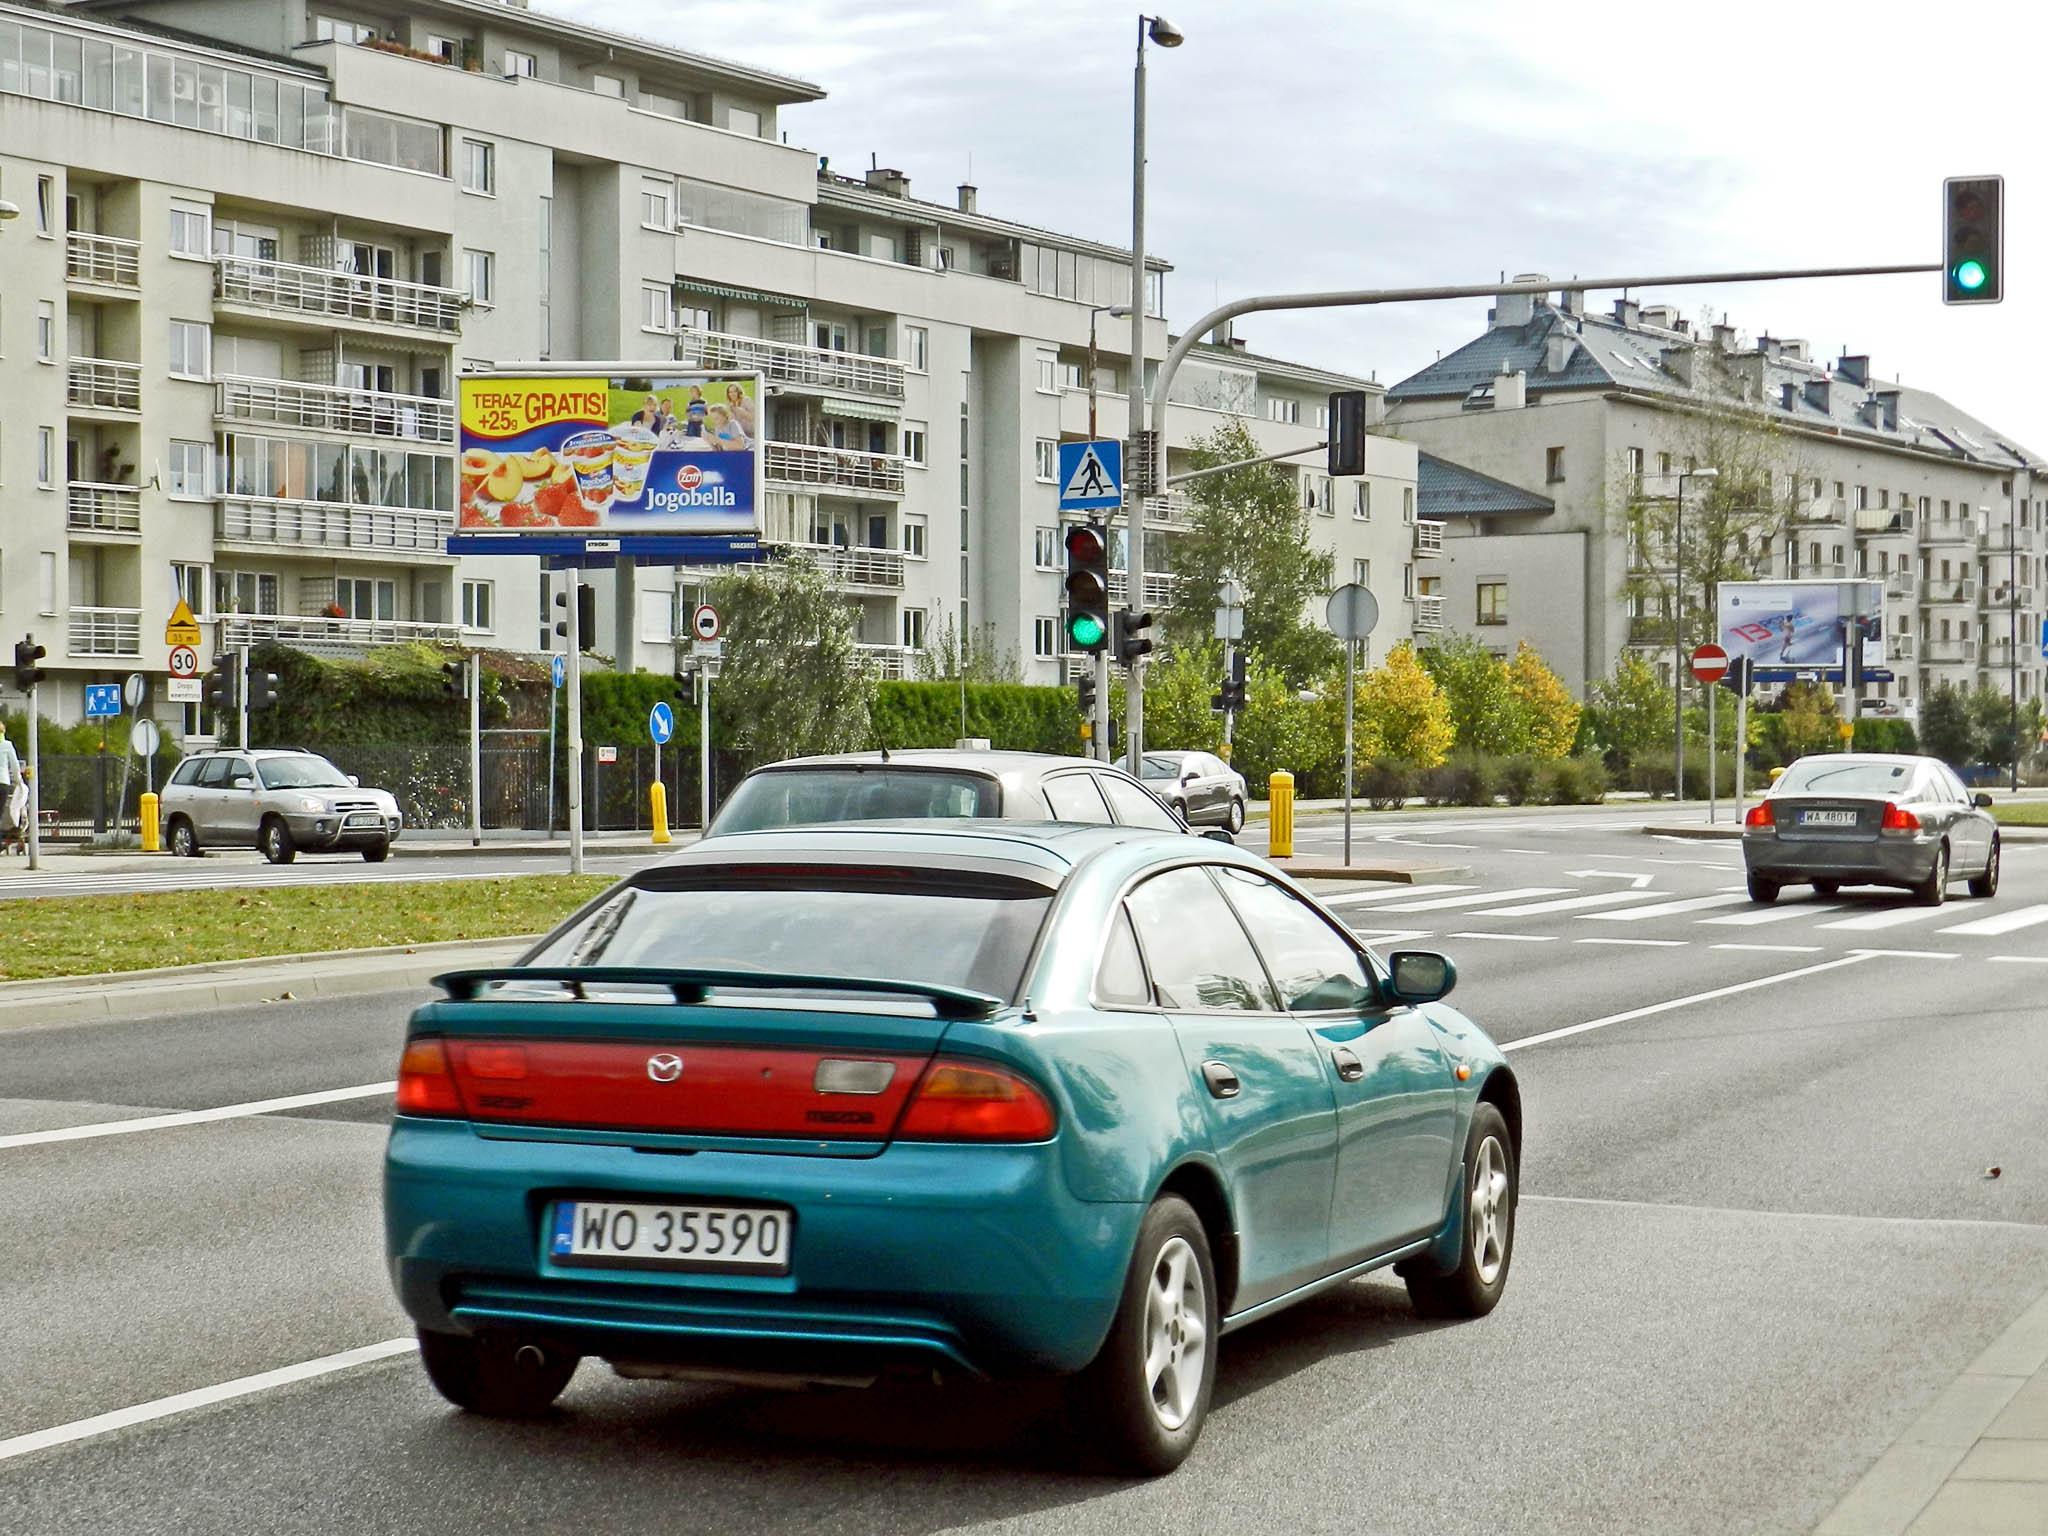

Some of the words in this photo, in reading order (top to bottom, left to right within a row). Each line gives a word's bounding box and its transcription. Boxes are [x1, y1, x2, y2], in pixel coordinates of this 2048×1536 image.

[472, 393, 522, 409] TERAZ
[525, 392, 607, 424] GRATIS!
[478, 410, 518, 431] +25g
[644, 486, 736, 512] Jogobella
[174, 653, 194, 670] 30
[1806, 811, 1820, 823] WA
[1824, 811, 1856, 824] 48014
[582, 1207, 637, 1251] WO
[652, 1210, 781, 1258] 35590
